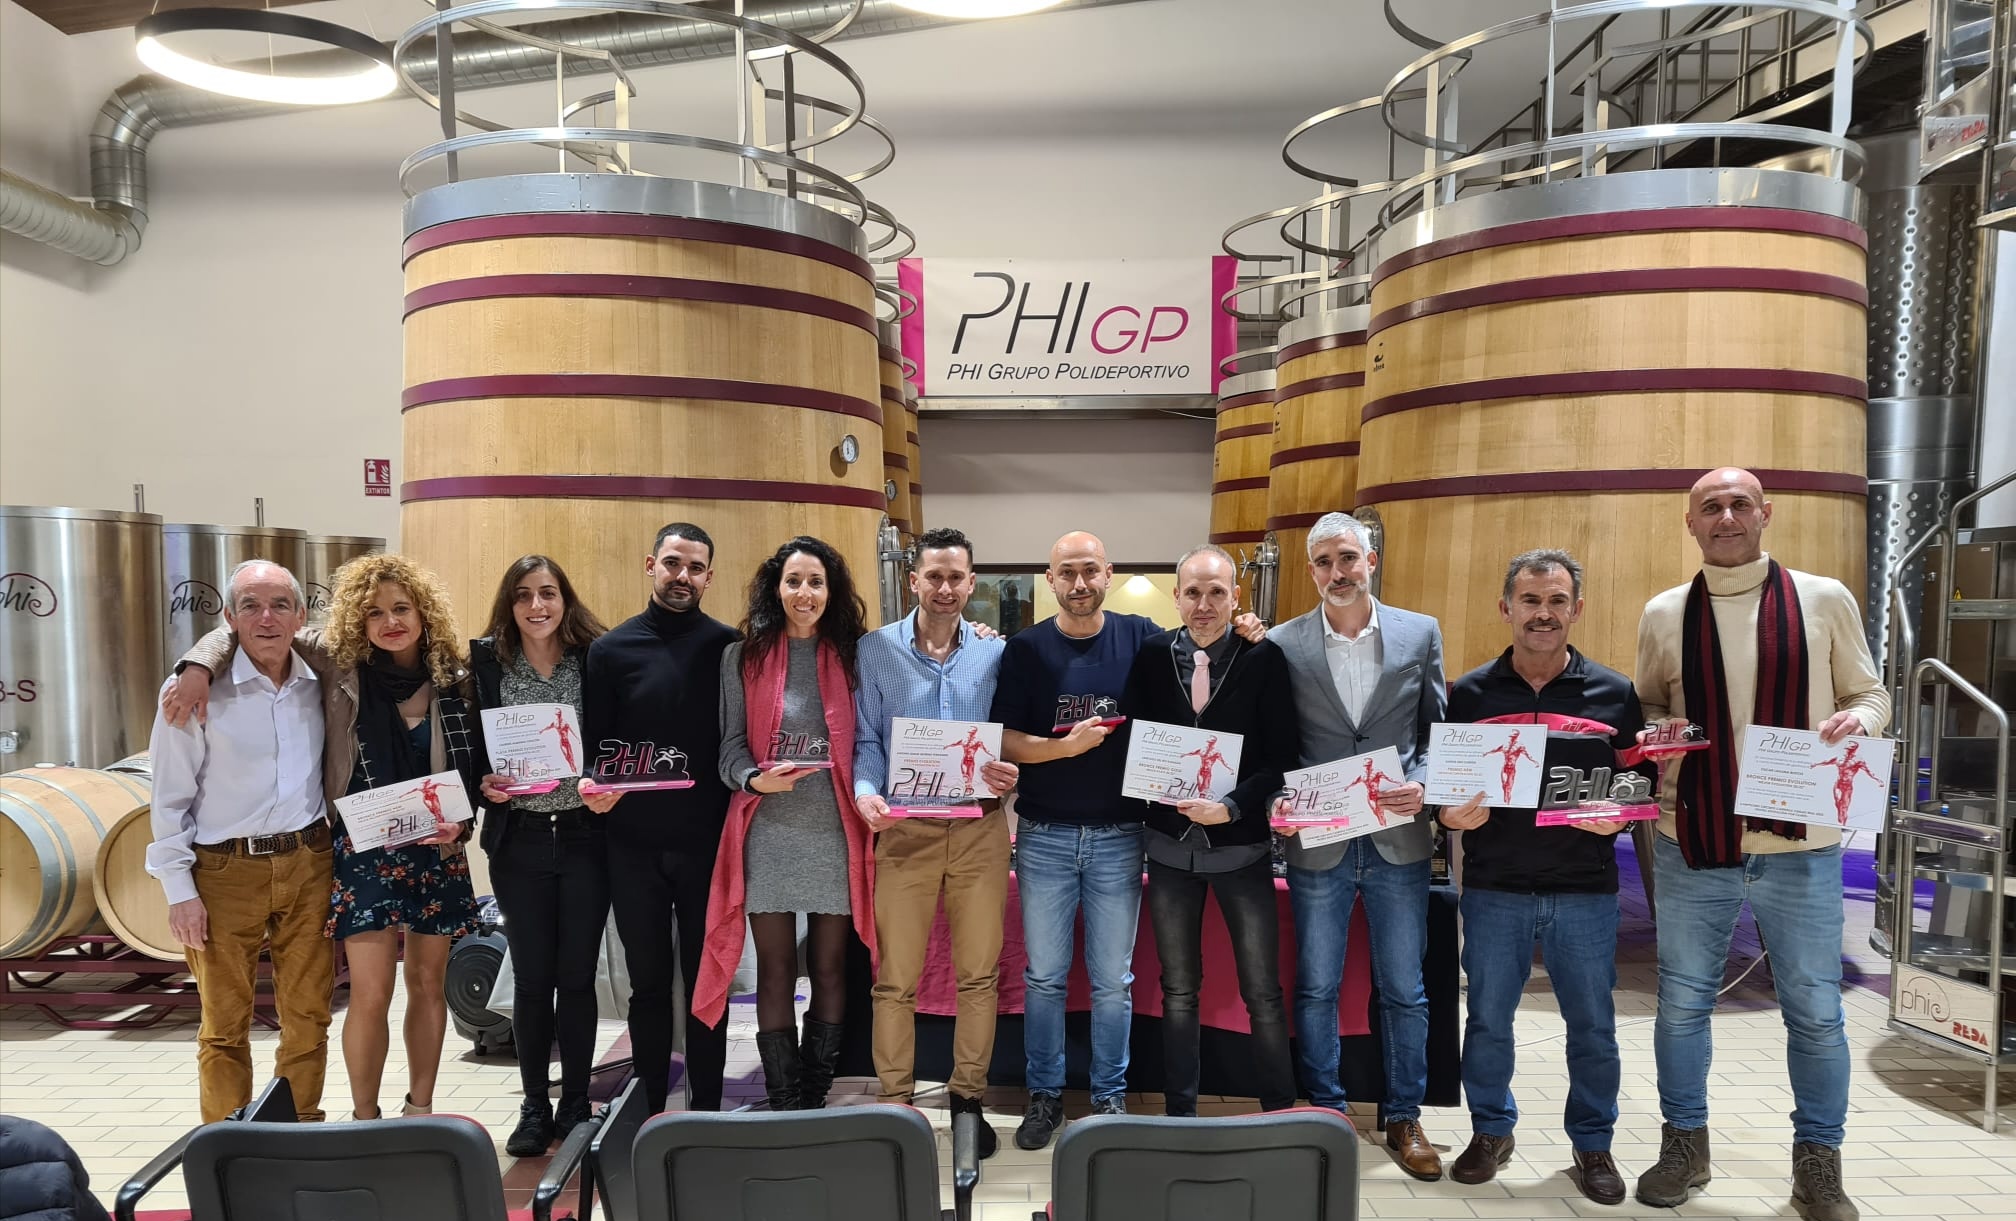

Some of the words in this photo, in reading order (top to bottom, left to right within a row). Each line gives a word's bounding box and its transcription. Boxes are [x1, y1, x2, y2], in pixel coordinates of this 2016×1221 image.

[947, 364, 983, 380] PHI
[988, 363, 1050, 380] GRUPO
[1054, 362, 1190, 380] POLIDEPORTIVO
